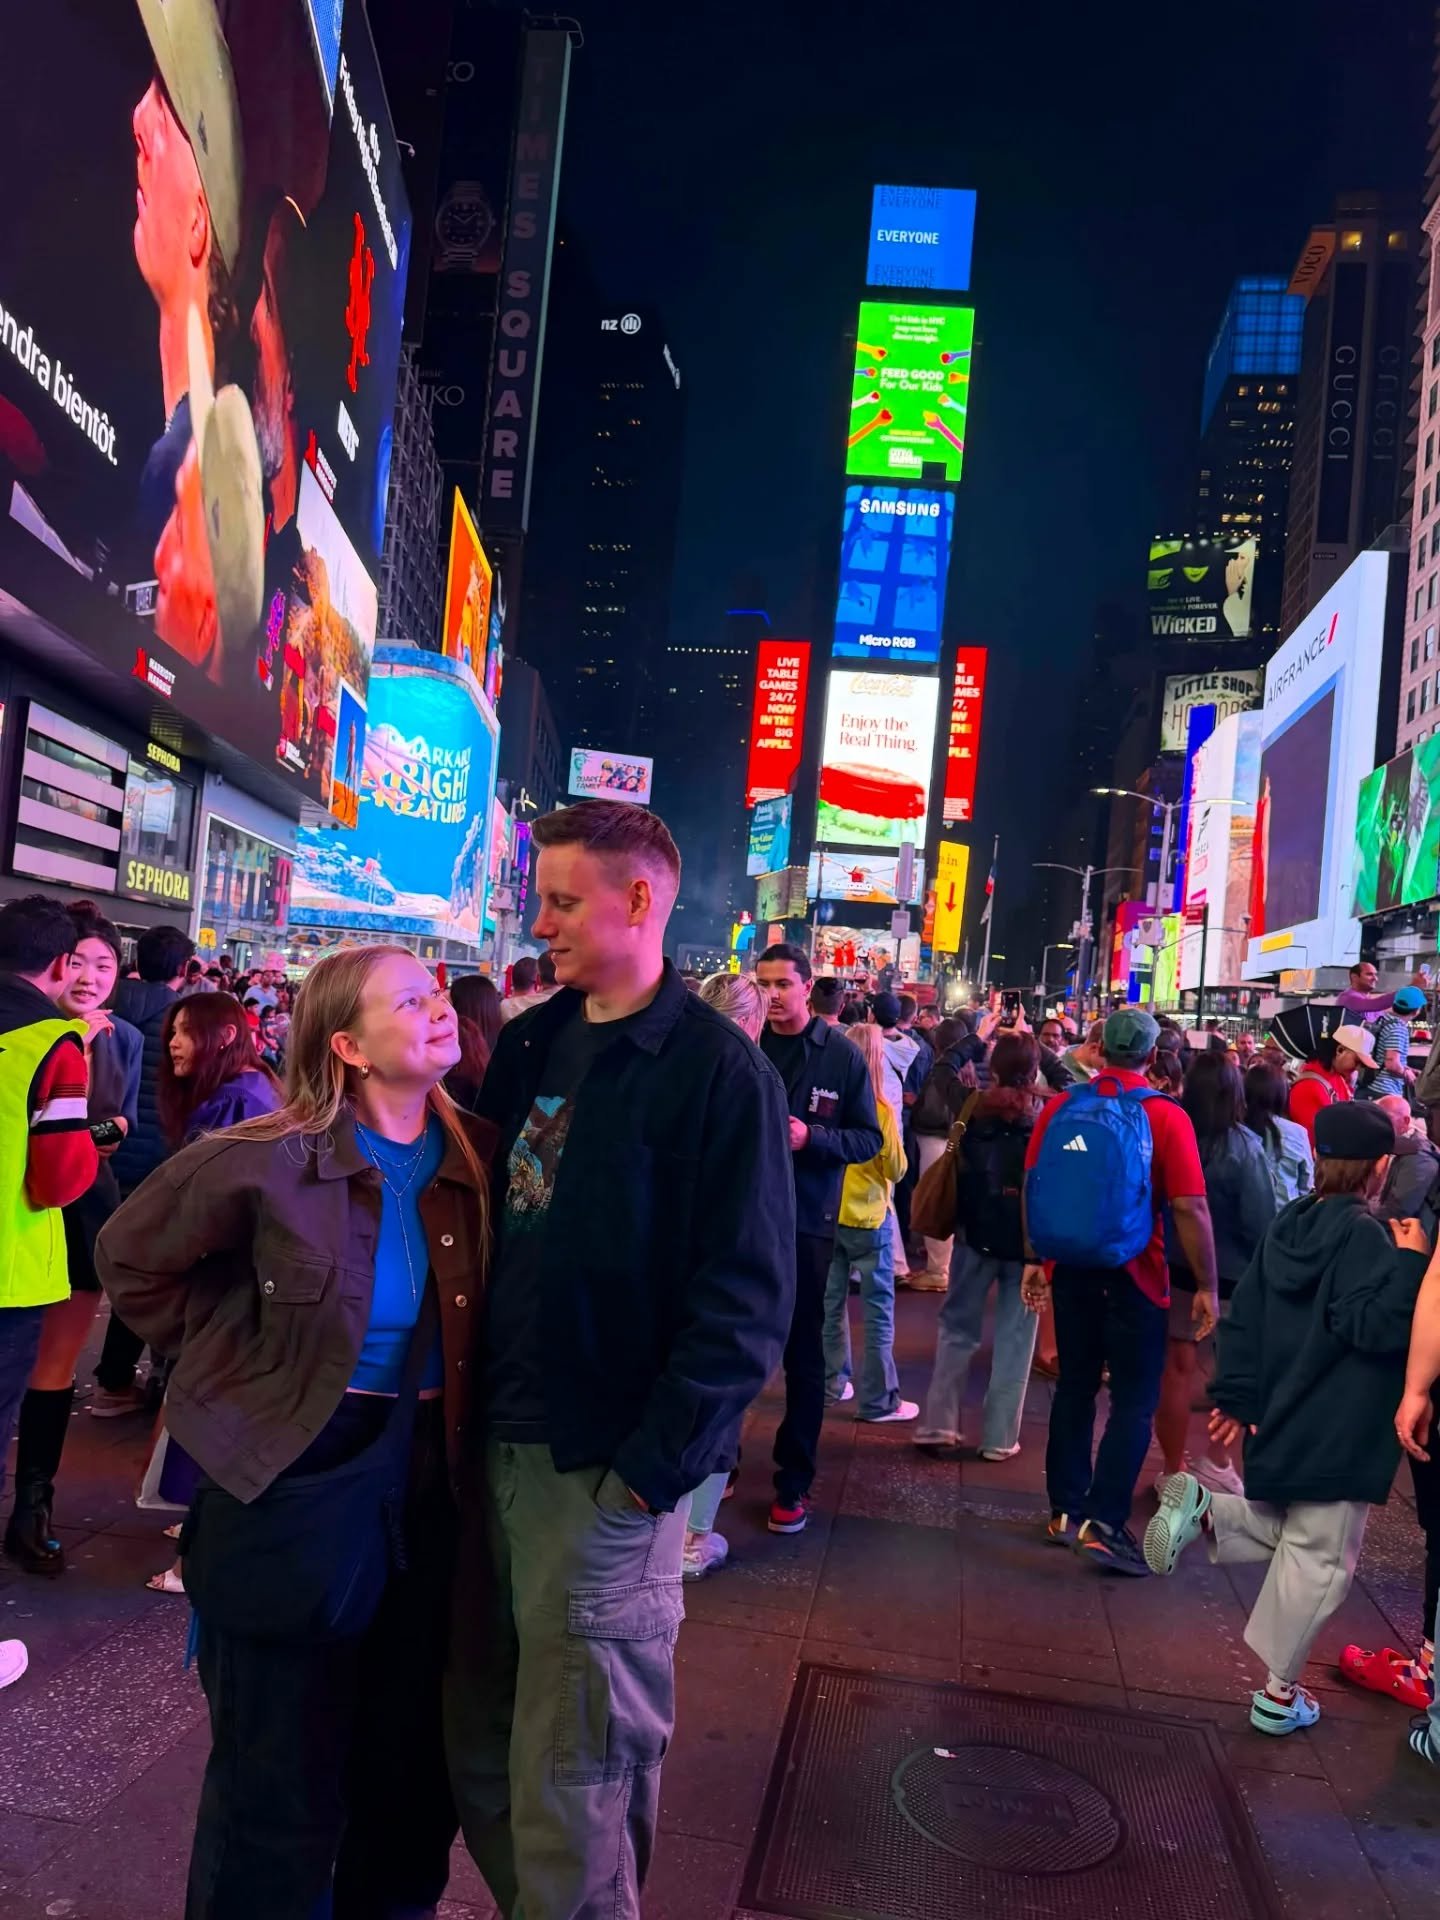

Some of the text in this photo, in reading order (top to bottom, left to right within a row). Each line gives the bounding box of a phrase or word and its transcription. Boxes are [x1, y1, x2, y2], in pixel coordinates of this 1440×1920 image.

[877, 229, 940, 245] EVERYONE
[881, 368, 944, 381] FEED GOOD
[490, 270, 532, 498] SQUARE
[880, 380, 897, 389] For
[899, 380, 920, 391] Our
[1328, 345, 1356, 459] GUCCI
[53, 360, 118, 466] bientôt.
[860, 498, 940, 517] SAMSUNG
[859, 634, 916, 648] Micro RGB
[777, 657, 800, 668] LIVE
[767, 668, 799, 679] TABLE
[759, 680, 798, 691] GAMES
[955, 675, 974, 686] BLE
[953, 687, 980, 698] MES
[1174, 676, 1253, 701] LITTLE SHOP
[769, 691, 797, 704] 24/7,
[767, 703, 797, 714] NOW
[760, 715, 794, 726] IN THE
[840, 713, 909, 732] Enjoy the
[775, 727, 793, 738] BIG
[839, 731, 918, 752] Real Thing.
[147, 742, 181, 773] SEPHORA
[127, 860, 190, 901] SEPHORA
